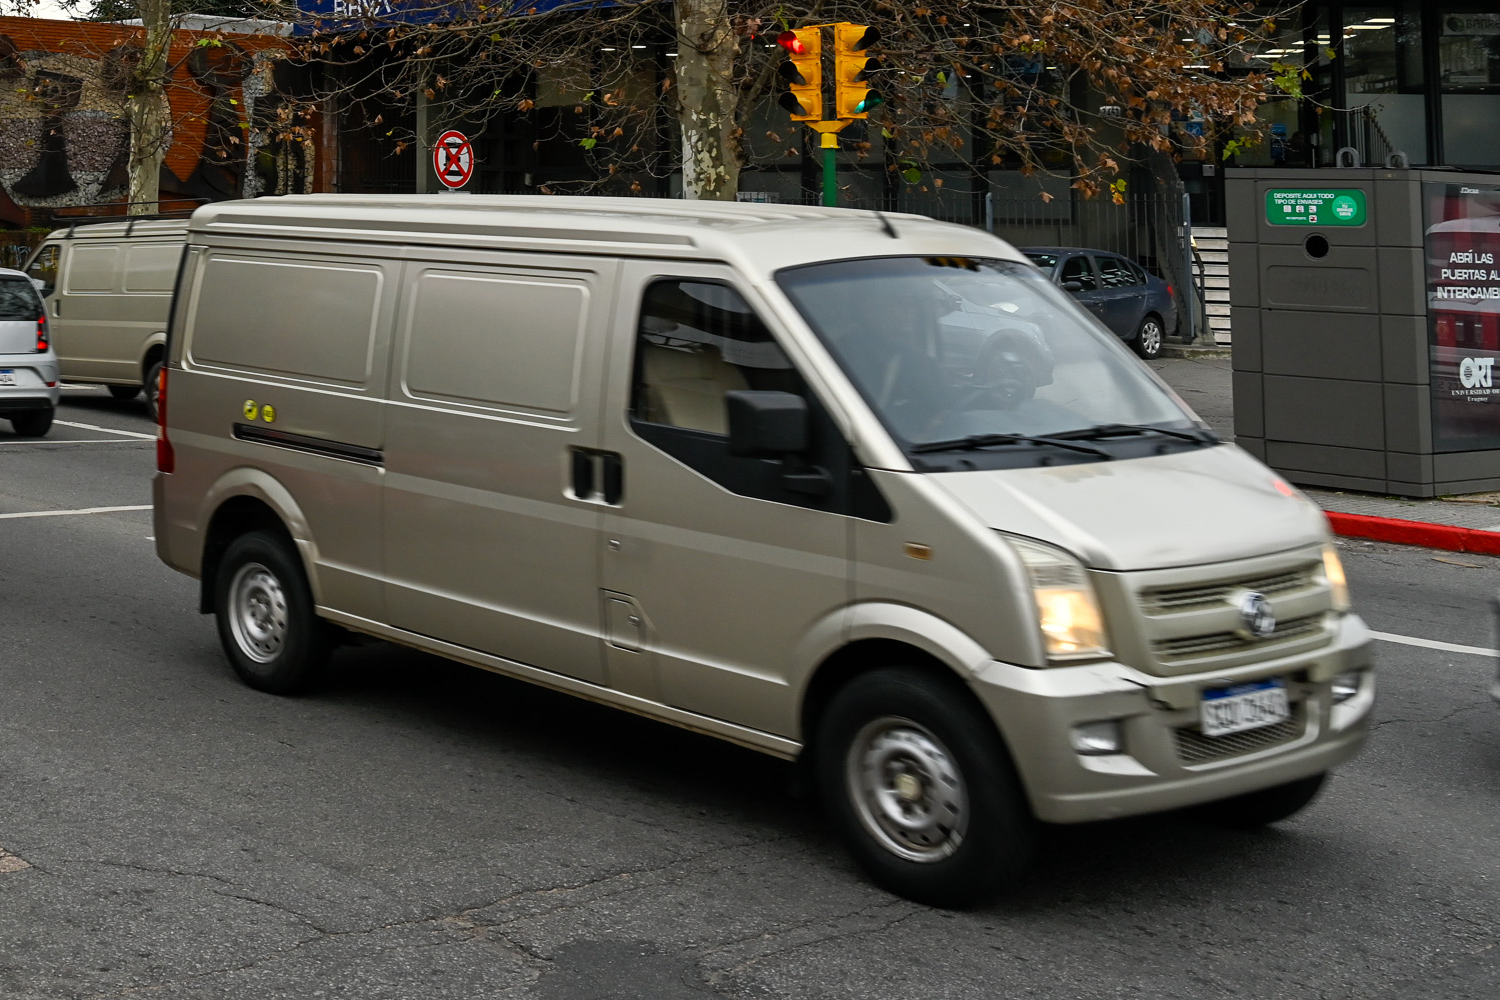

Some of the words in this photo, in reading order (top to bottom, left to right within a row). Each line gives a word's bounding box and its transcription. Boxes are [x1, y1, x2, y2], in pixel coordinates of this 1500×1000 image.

[1449, 249, 1473, 264] ABRÍ
[1474, 253, 1494, 264] LAS
[1441, 268, 1487, 280] PUERTAS
[1460, 357, 1494, 388] ORT
[1451, 388, 1491, 396] UNIVERSIDAD
